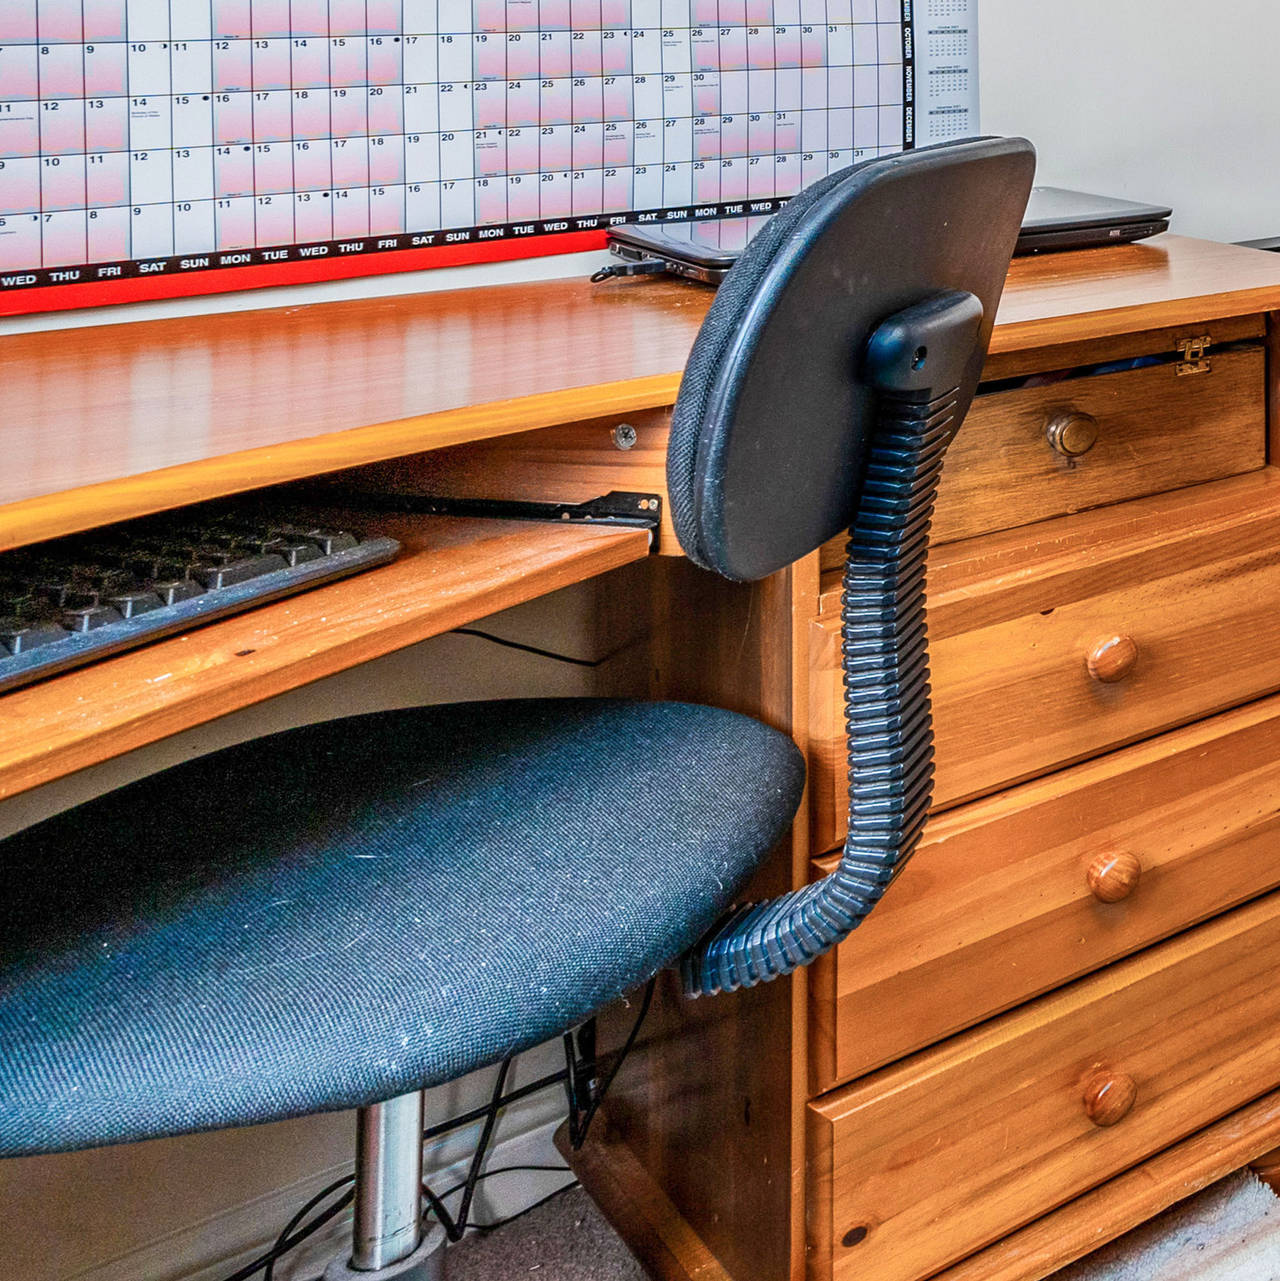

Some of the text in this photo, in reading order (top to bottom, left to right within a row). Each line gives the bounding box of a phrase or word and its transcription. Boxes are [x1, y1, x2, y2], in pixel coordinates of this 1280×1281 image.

[1, 249, 289, 287] WED THU FRI SAT SUN MON TUE
